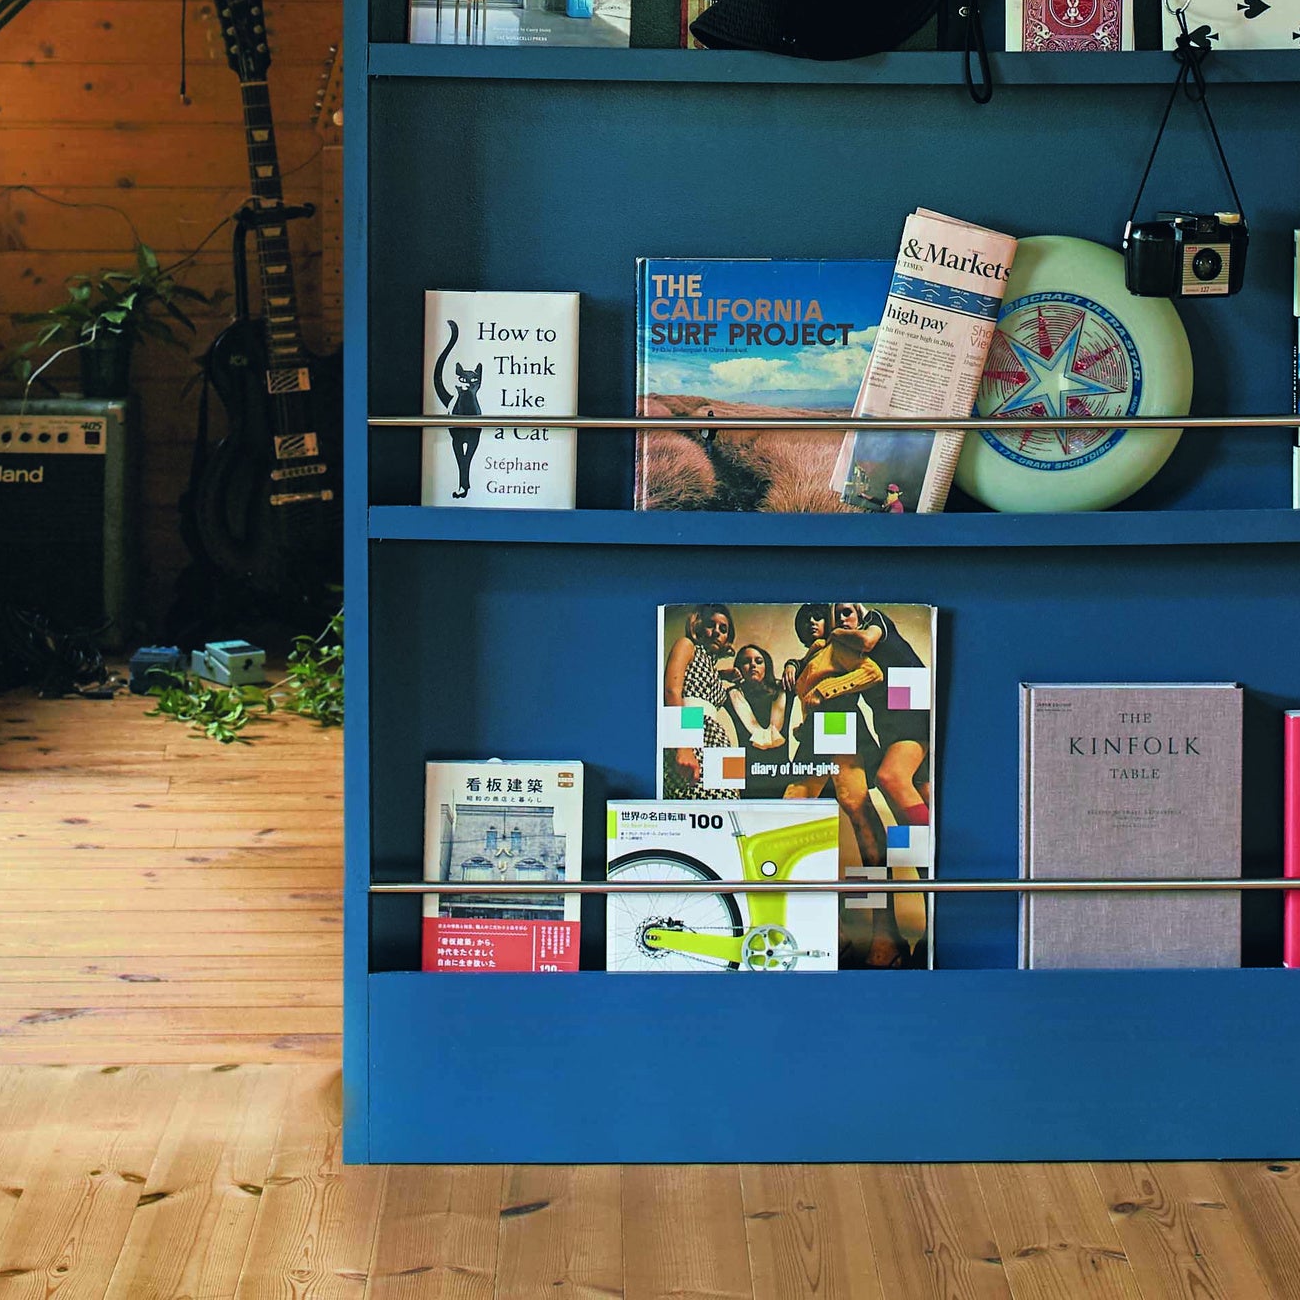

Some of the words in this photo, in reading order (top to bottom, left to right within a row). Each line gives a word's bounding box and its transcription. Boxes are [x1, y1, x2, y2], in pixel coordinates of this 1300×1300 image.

[903, 238, 924, 260] &
[923, 243, 1013, 282] Markets
[903, 261, 924, 272] TIMES
[651, 275, 702, 297] THE
[651, 298, 823, 322] CALIFORNIA
[1004, 292, 1083, 314] DISCRAFT
[887, 303, 919, 325] high
[920, 316, 949, 334] pay
[477, 322, 529, 342] How
[536, 326, 557, 342] to
[651, 323, 718, 346] SURF
[729, 323, 854, 346] PROJECT
[920, 332, 933, 344] high
[1084, 299, 1141, 382] ULTRA-STAR
[493, 355, 556, 376] Think
[501, 388, 545, 408] Like
[494, 428, 505, 440] a
[513, 428, 549, 441] Cat
[1054, 441, 1112, 470] SPORTDISC
[484, 456, 549, 475] Stéphane
[486, 480, 541, 495] Garnier
[1119, 712, 1152, 724] THE
[1069, 737, 1200, 756] KINFOLK
[751, 762, 778, 777] diary
[780, 762, 790, 775] of
[792, 762, 840, 777] bird-girls
[1109, 768, 1161, 780] TABLE
[466, 777, 543, 793] 看板建築
[621, 811, 687, 821] 世界の名自転車
[689, 813, 724, 830] 100
